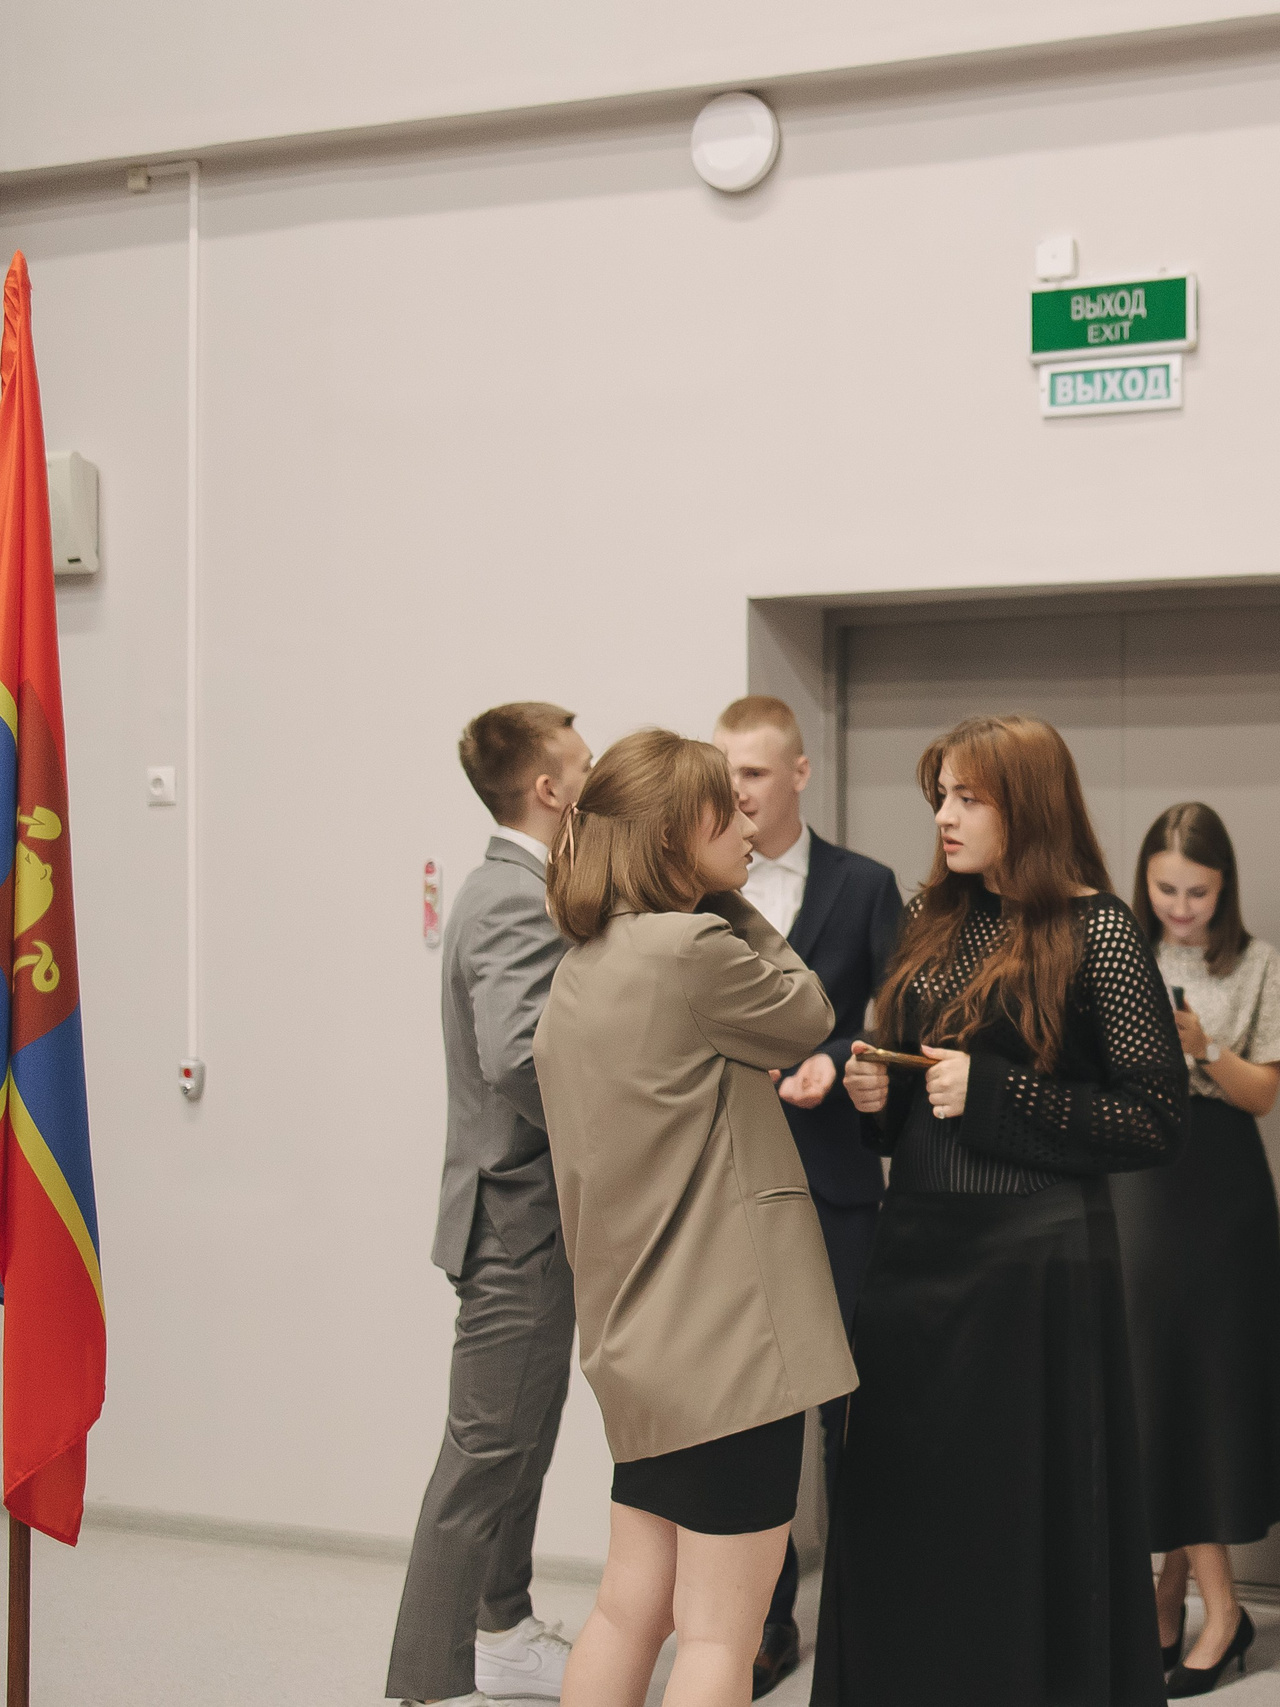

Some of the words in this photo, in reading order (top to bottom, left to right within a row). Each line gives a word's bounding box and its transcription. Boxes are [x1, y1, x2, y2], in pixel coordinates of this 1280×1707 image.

[1070, 288, 1148, 321] ВЫХОД
[1087, 321, 1133, 343] EXIT
[1054, 367, 1169, 406] ВЫХОД
